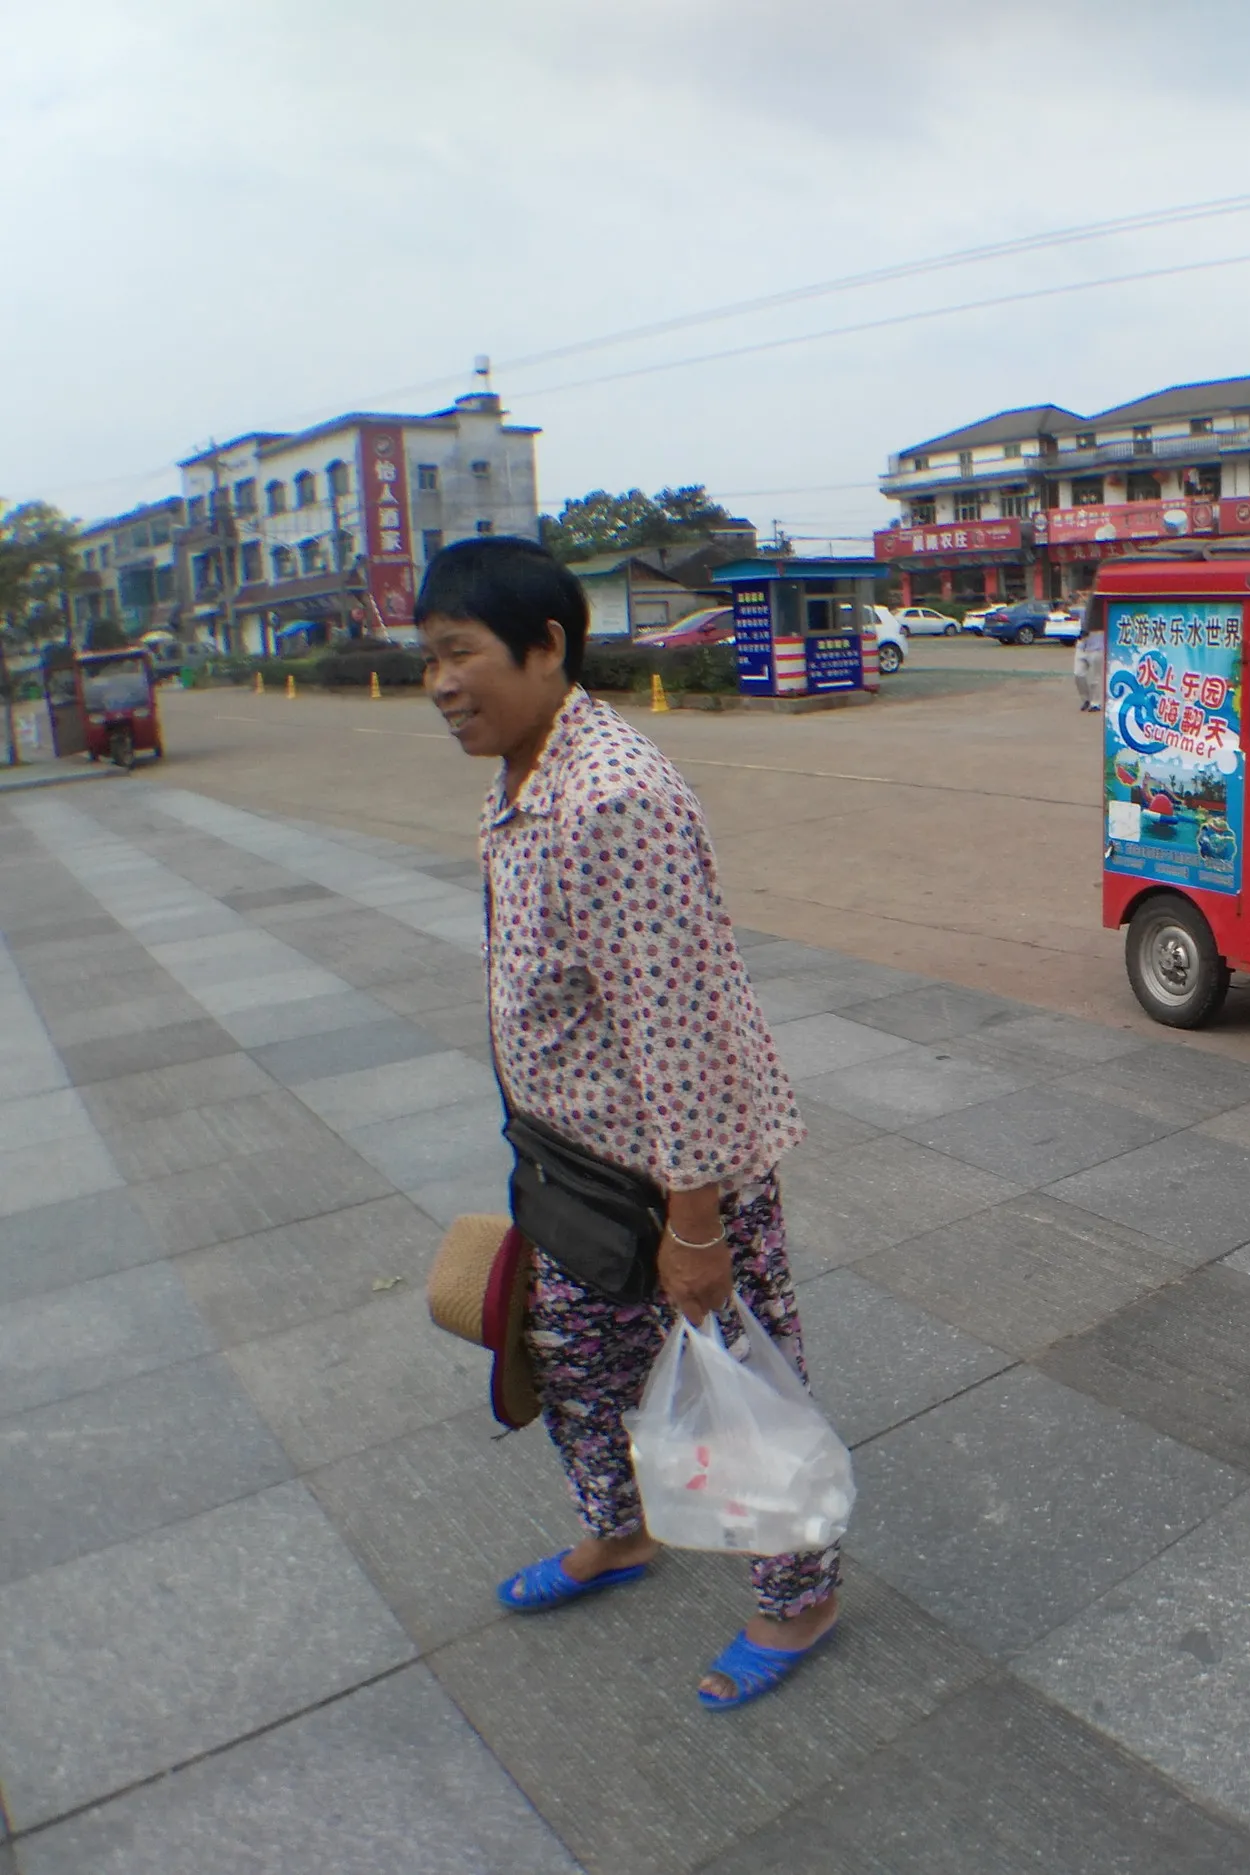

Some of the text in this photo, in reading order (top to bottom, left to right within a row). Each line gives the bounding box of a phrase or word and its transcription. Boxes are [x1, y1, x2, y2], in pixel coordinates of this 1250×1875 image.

[1118, 614, 1241, 648] 龙游欢乐水世界
[1137, 656, 1227, 709] 水上乐园
[1143, 724, 1216, 758] summer
[1158, 697, 1228, 748] 嗨翻天
